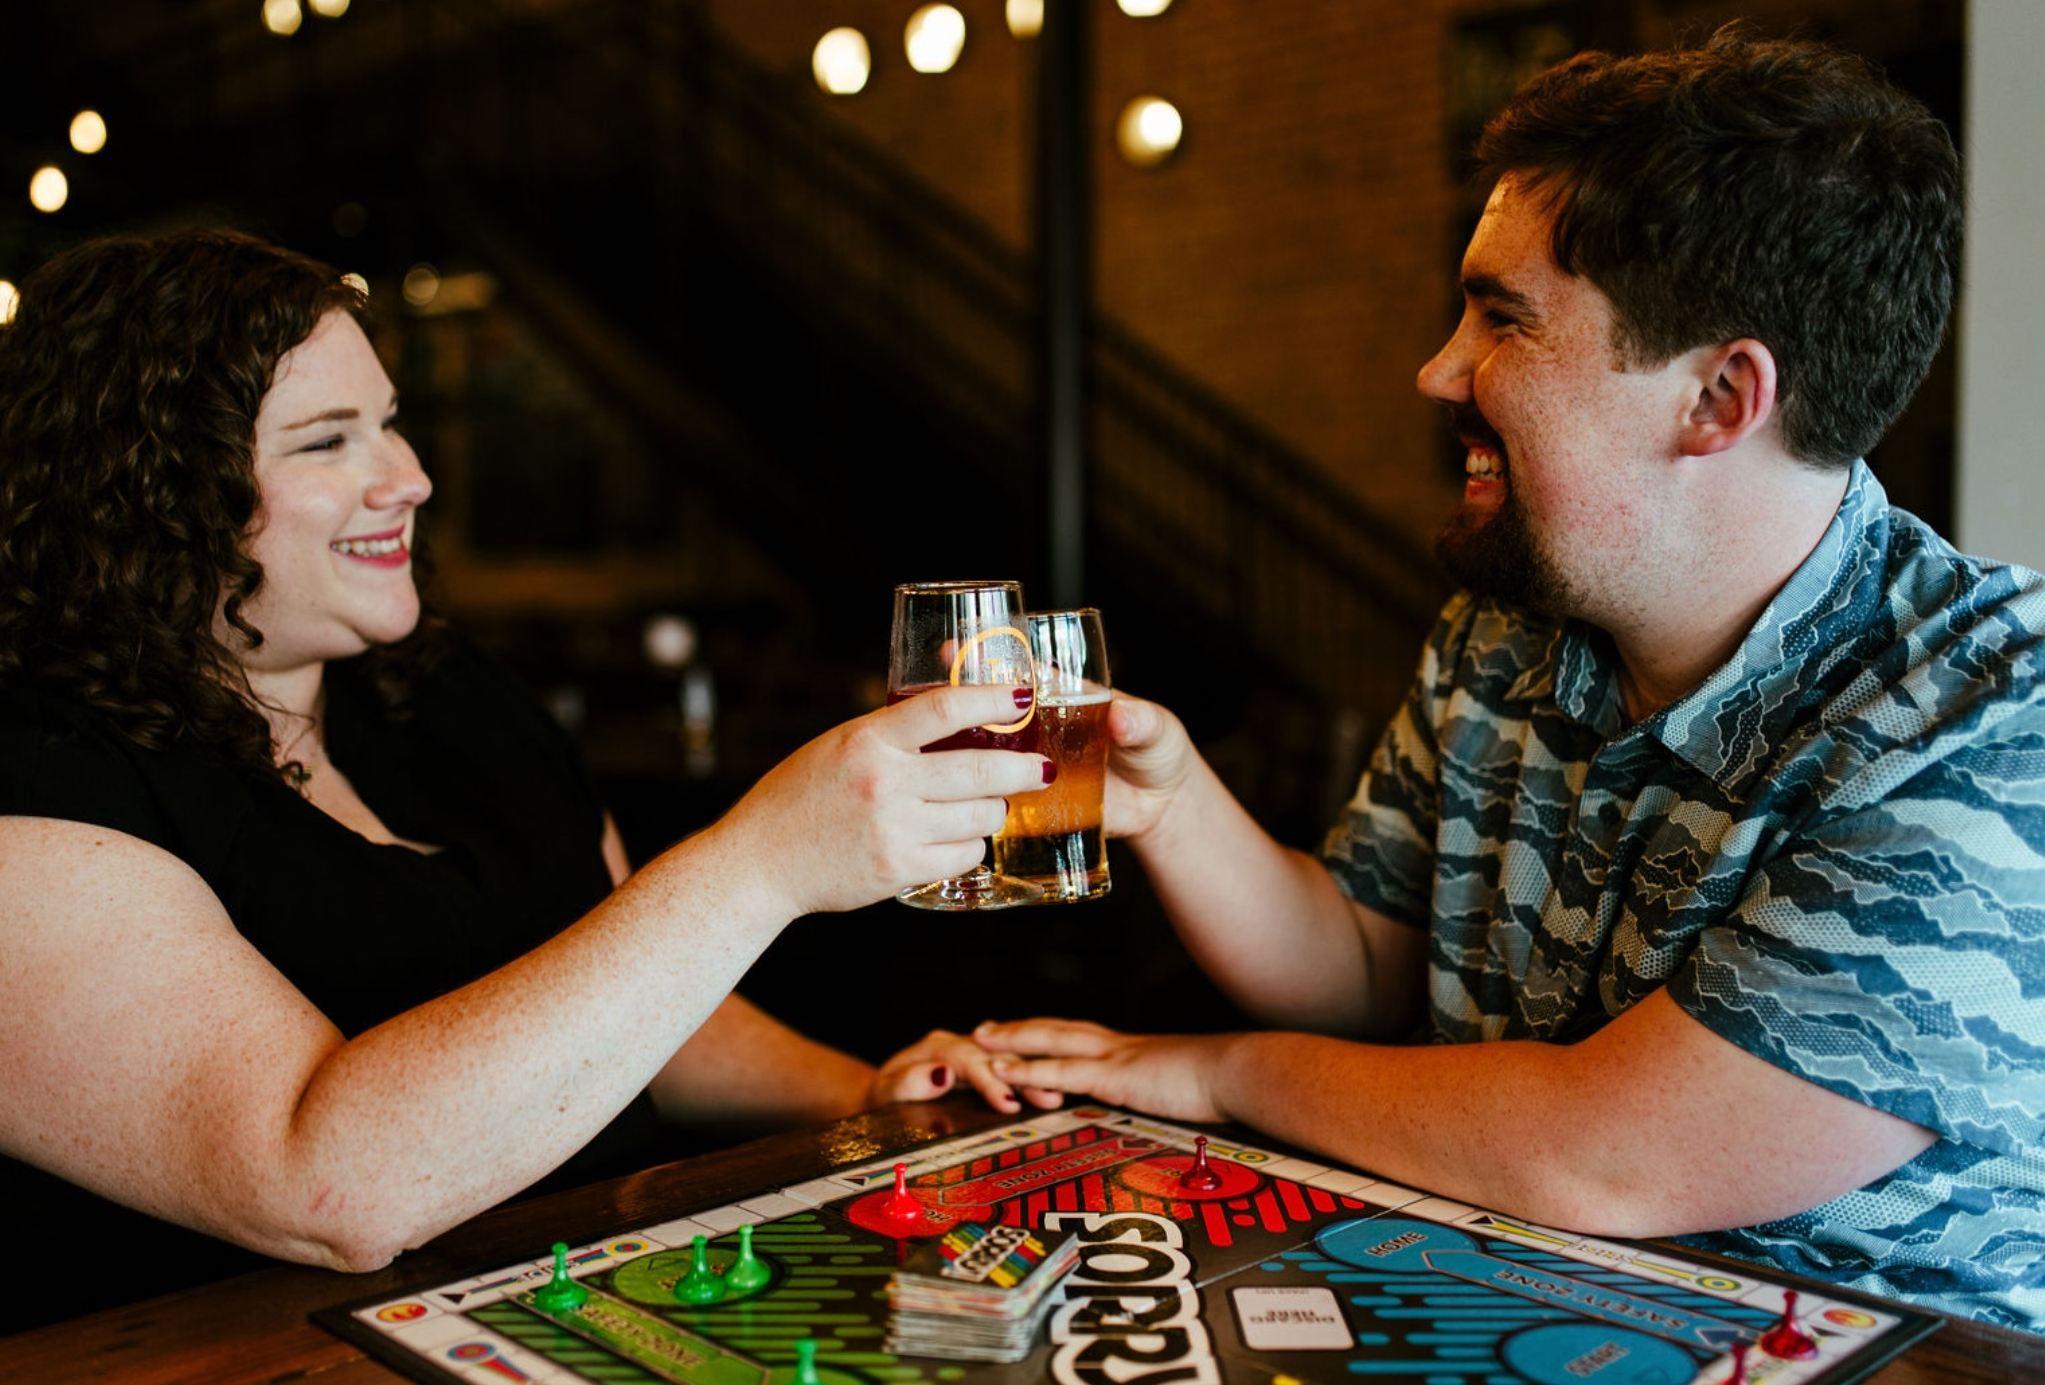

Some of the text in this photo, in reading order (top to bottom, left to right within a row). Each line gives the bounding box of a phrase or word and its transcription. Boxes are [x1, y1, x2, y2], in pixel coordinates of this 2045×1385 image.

[1365, 1231, 1428, 1257] HOME
[1494, 1269, 1688, 1330] SAFETY ZONE
